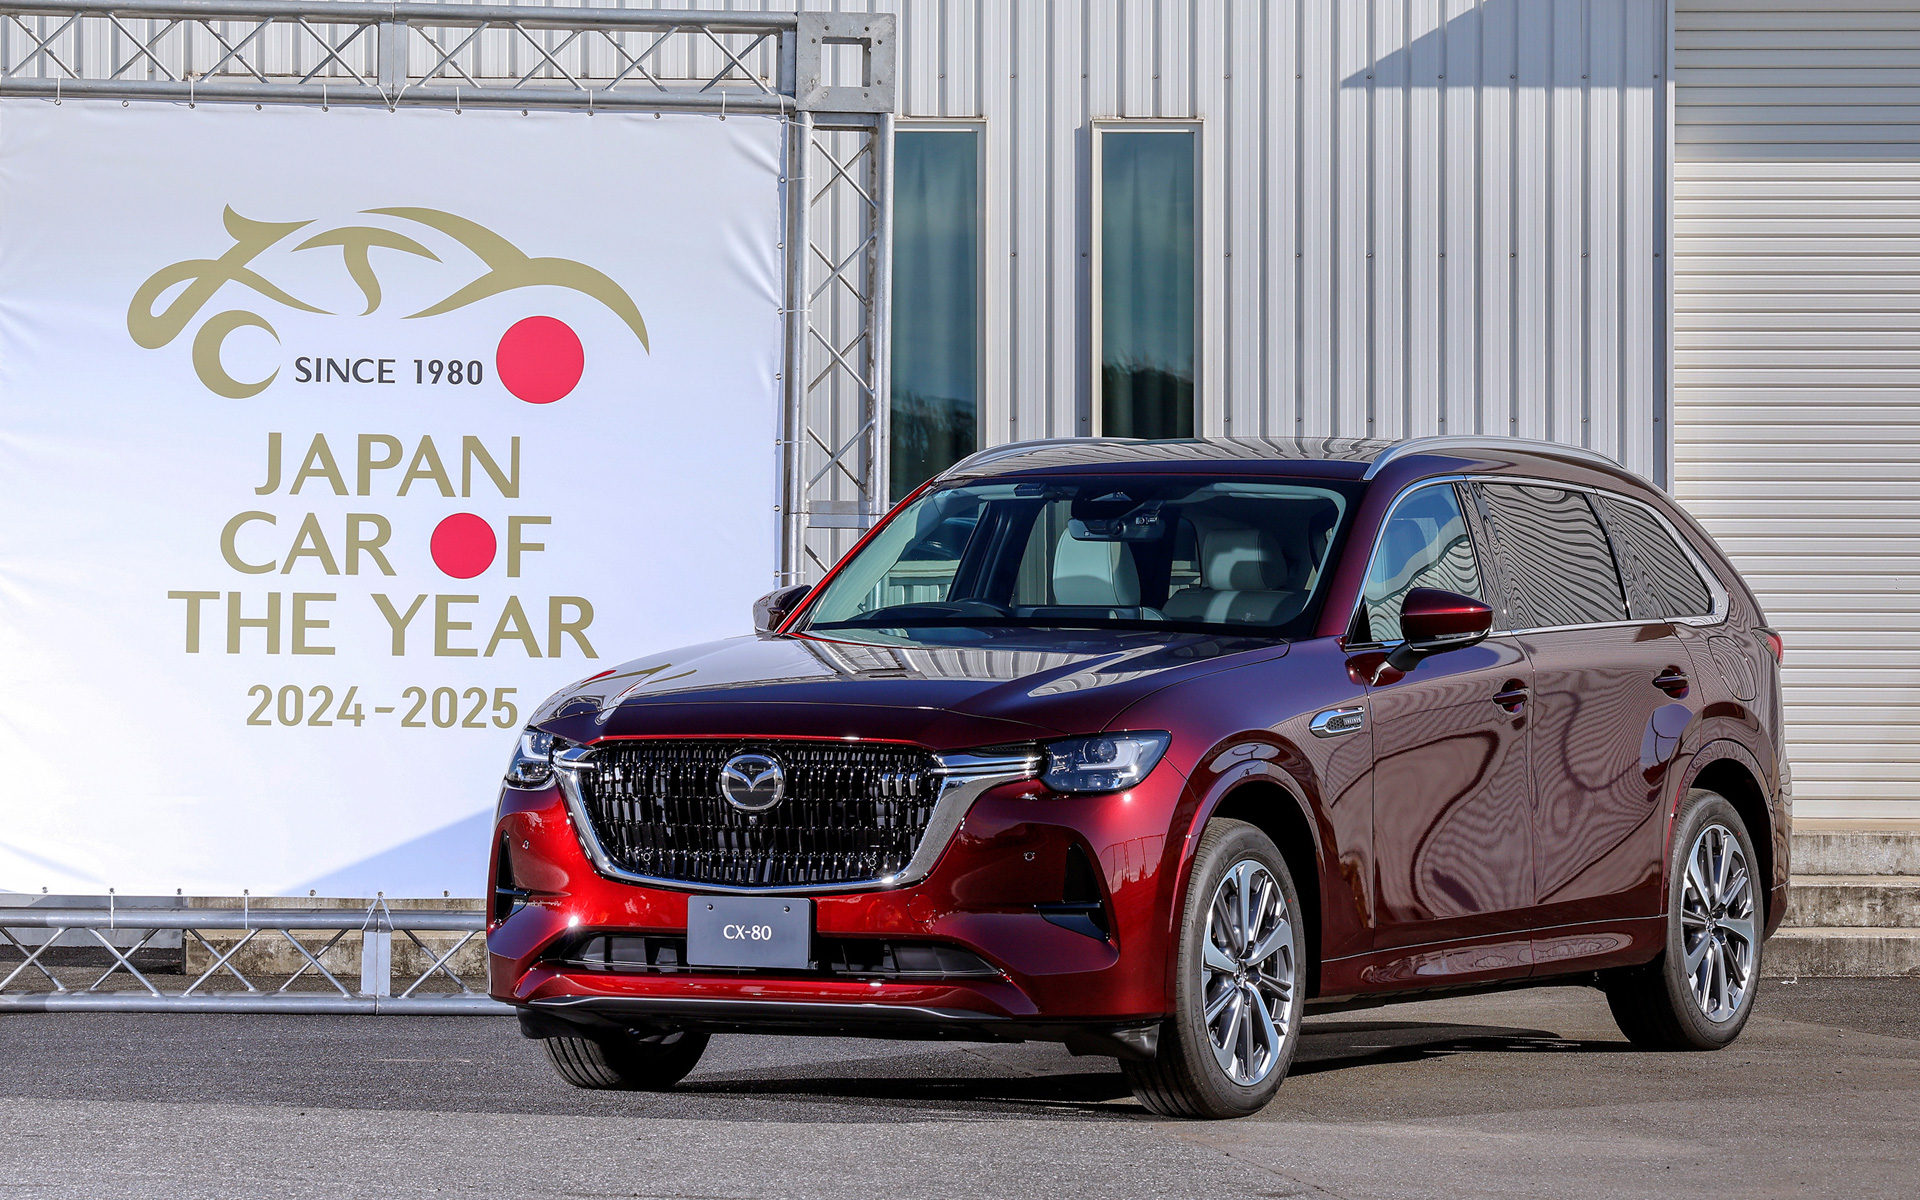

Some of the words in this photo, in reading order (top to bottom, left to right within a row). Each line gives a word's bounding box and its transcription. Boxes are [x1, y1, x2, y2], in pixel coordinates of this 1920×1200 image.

[294, 356, 396, 384] SINCE
[413, 359, 483, 385] 1980
[254, 432, 521, 499] JAPAN
[219, 510, 398, 577] CAR
[167, 590, 337, 656] THE
[370, 593, 600, 659] YEAR
[722, 924, 772, 941] CX-80
